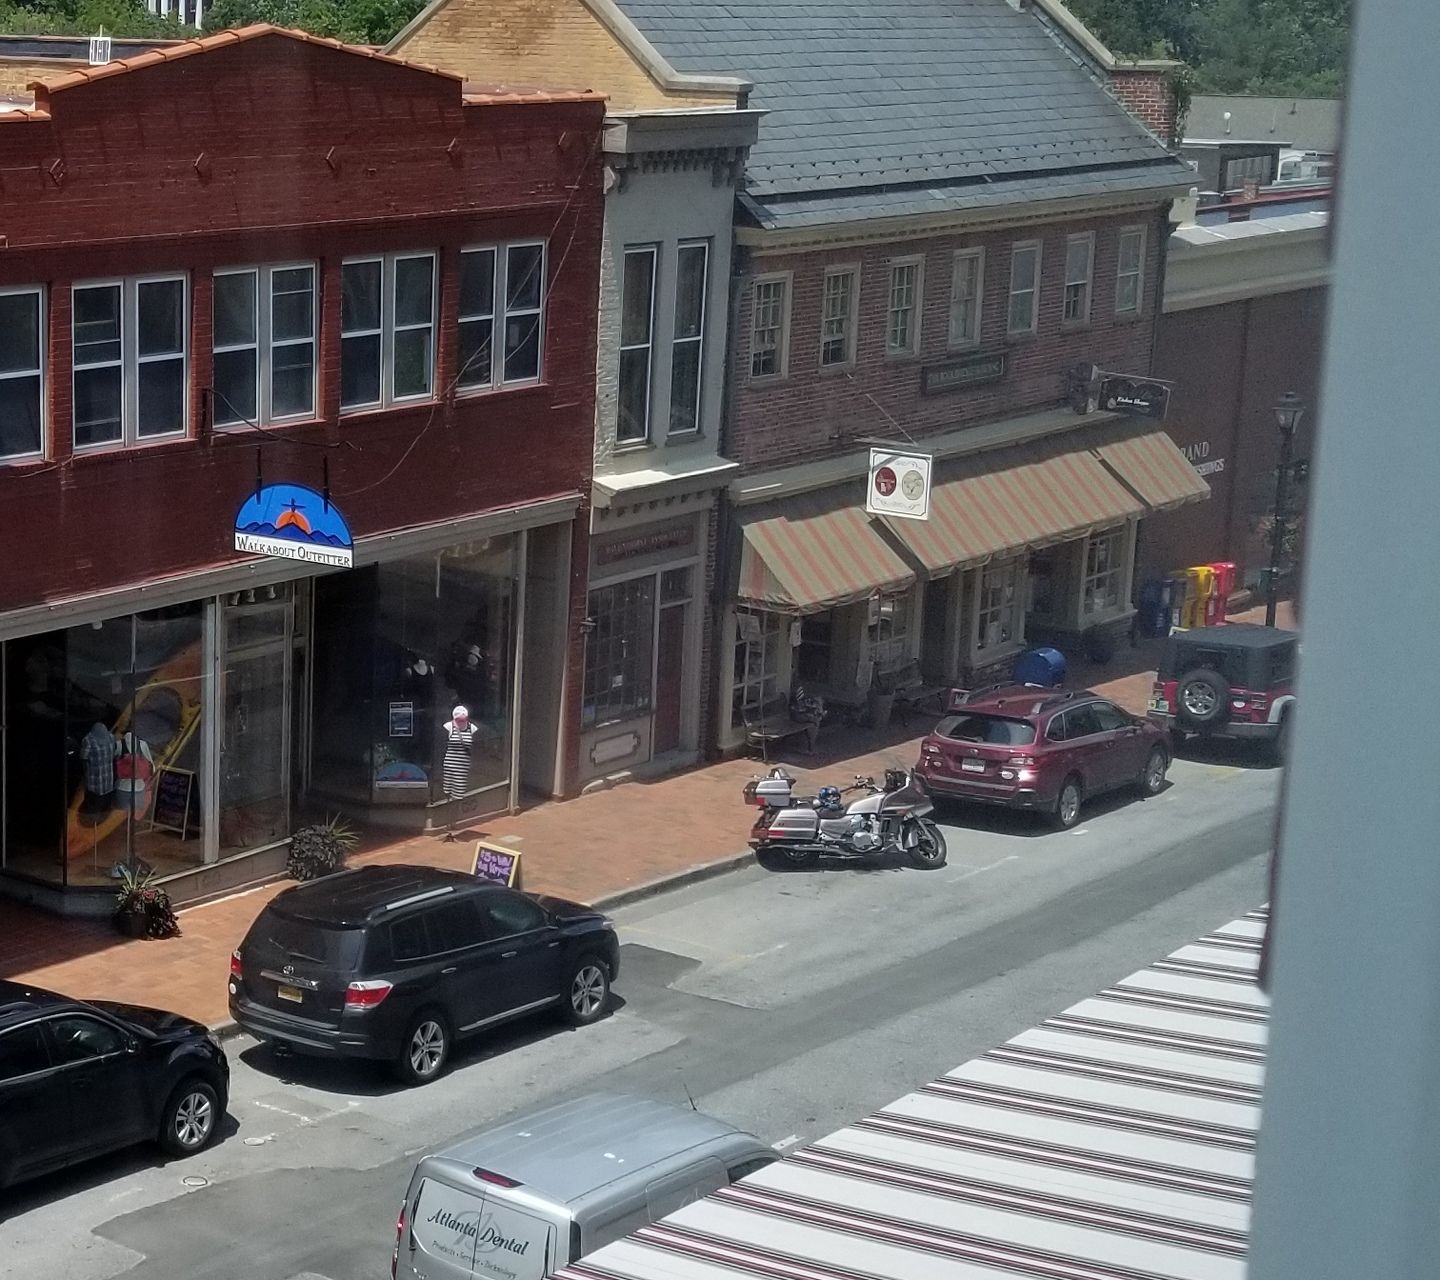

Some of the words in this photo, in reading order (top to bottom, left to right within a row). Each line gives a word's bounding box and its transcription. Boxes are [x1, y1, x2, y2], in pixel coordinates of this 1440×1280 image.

[237, 536, 295, 558] WALKABOUT
[297, 546, 350, 567] OUTFITTER
[427, 1208, 477, 1238] Atlanta
[480, 1227, 529, 1256] Dental
